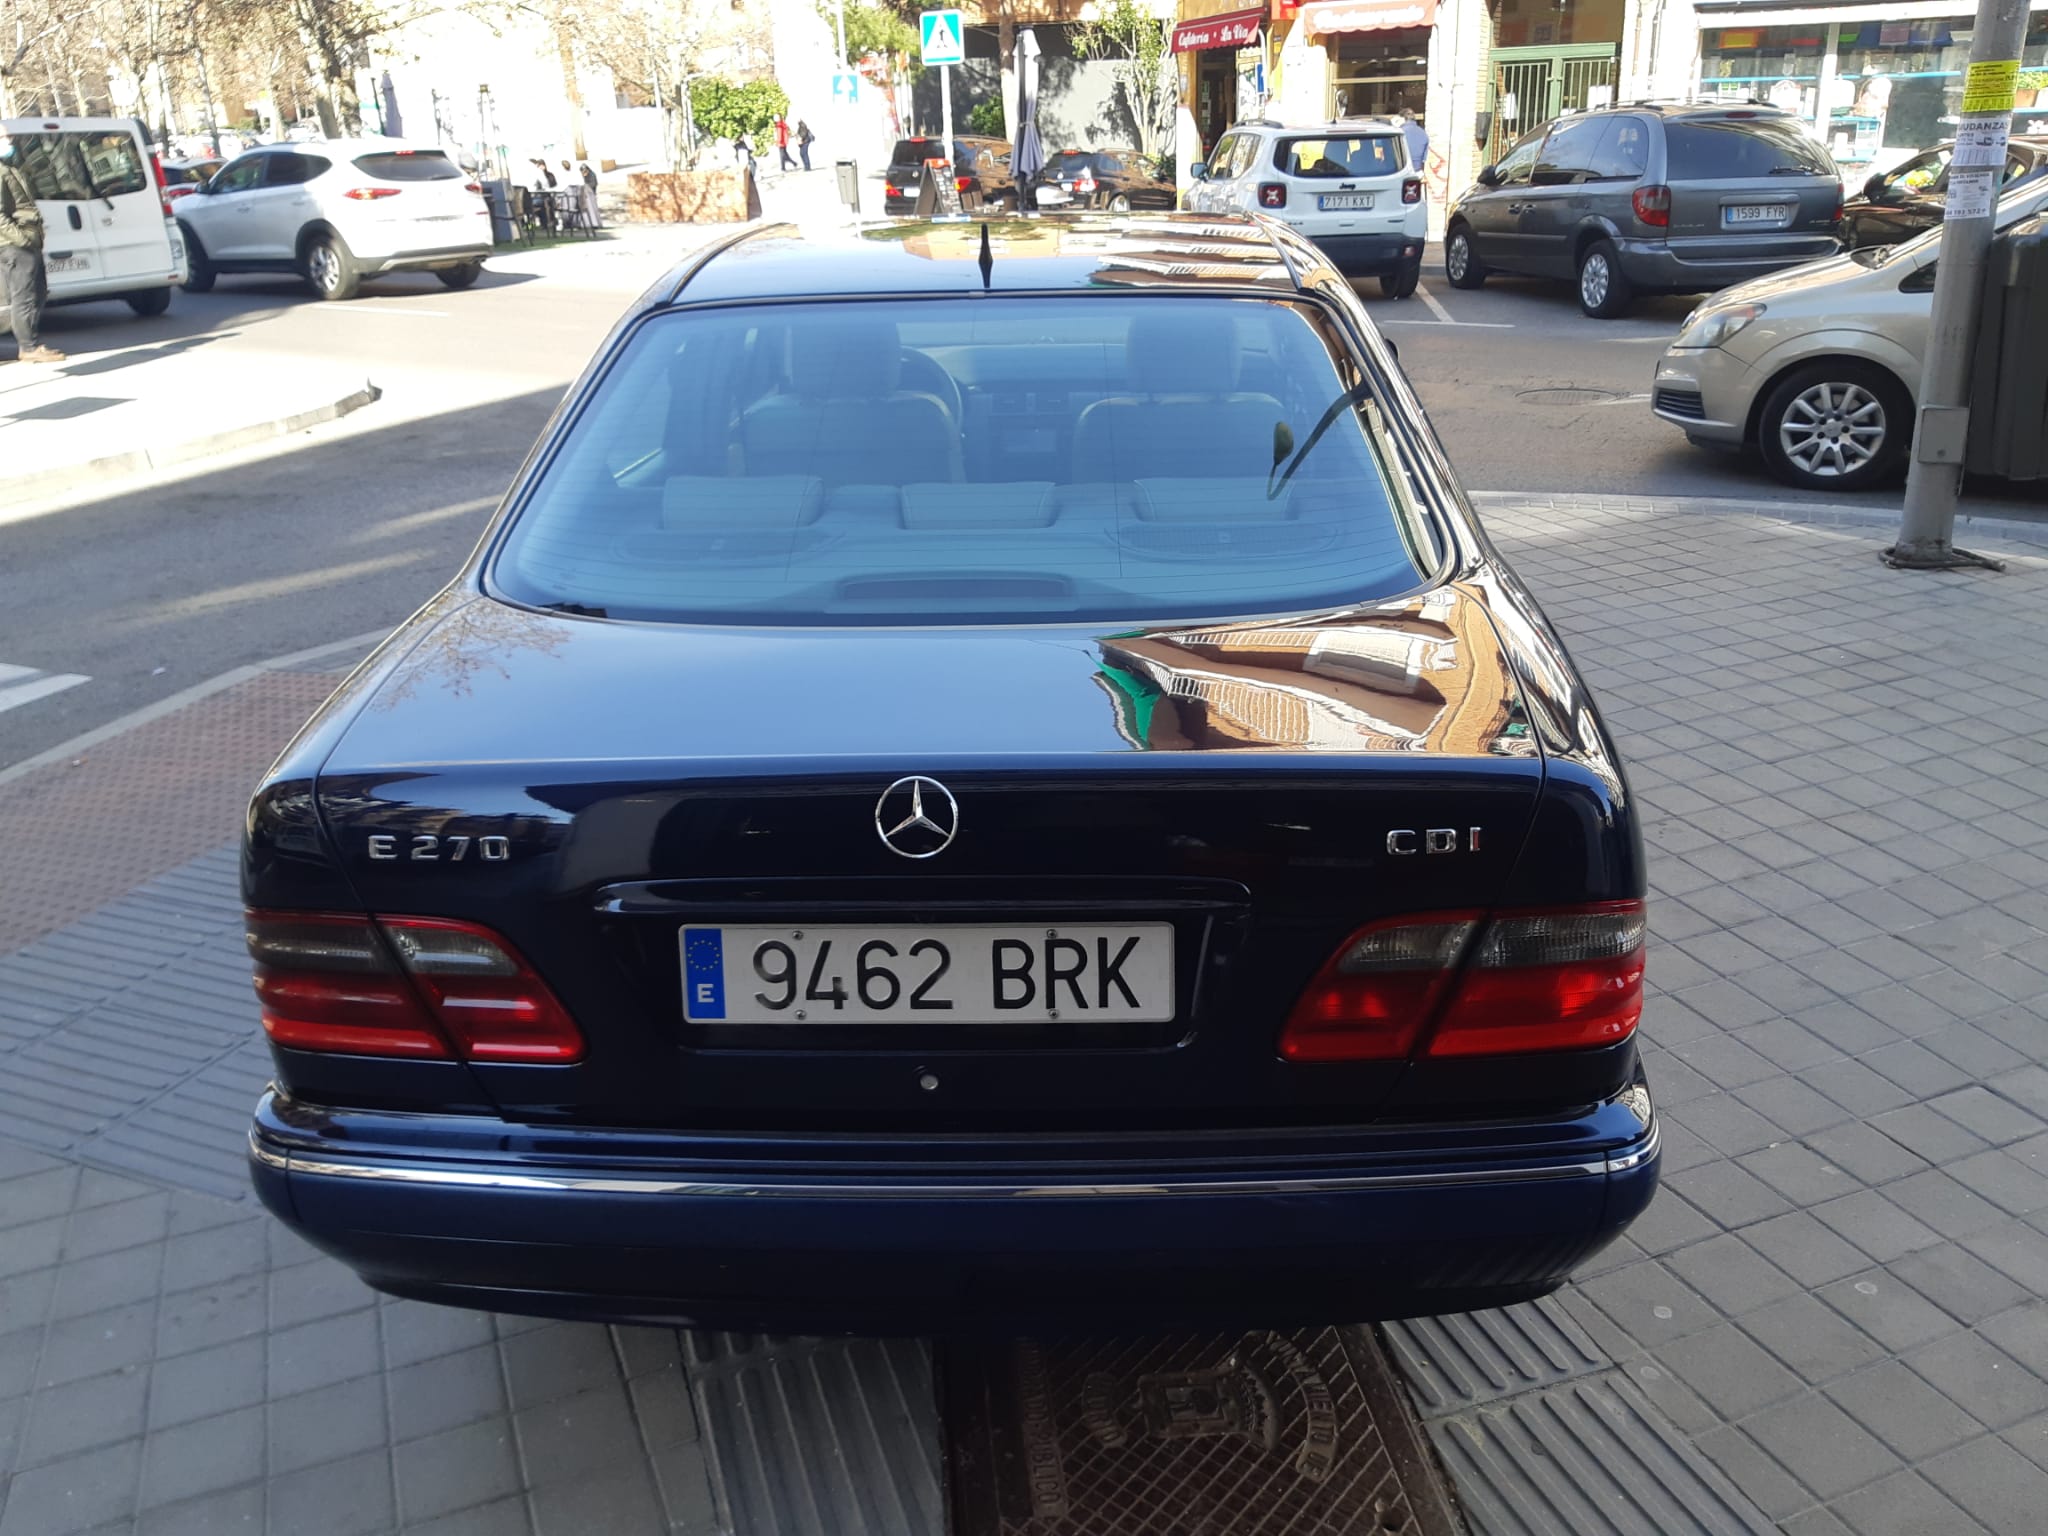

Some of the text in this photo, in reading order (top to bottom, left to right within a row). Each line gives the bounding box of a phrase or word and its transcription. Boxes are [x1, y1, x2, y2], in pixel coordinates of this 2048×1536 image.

[1325, 195, 1371, 209] 7171 KXT
[1736, 206, 1785, 220] 1599 FYR
[368, 835, 510, 861] E 270
[1386, 827, 1481, 855] CDI
[753, 936, 1141, 1011] 9462 BRK
[697, 984, 714, 1003] E
[1029, 1431, 1061, 1503] PUBLICO
